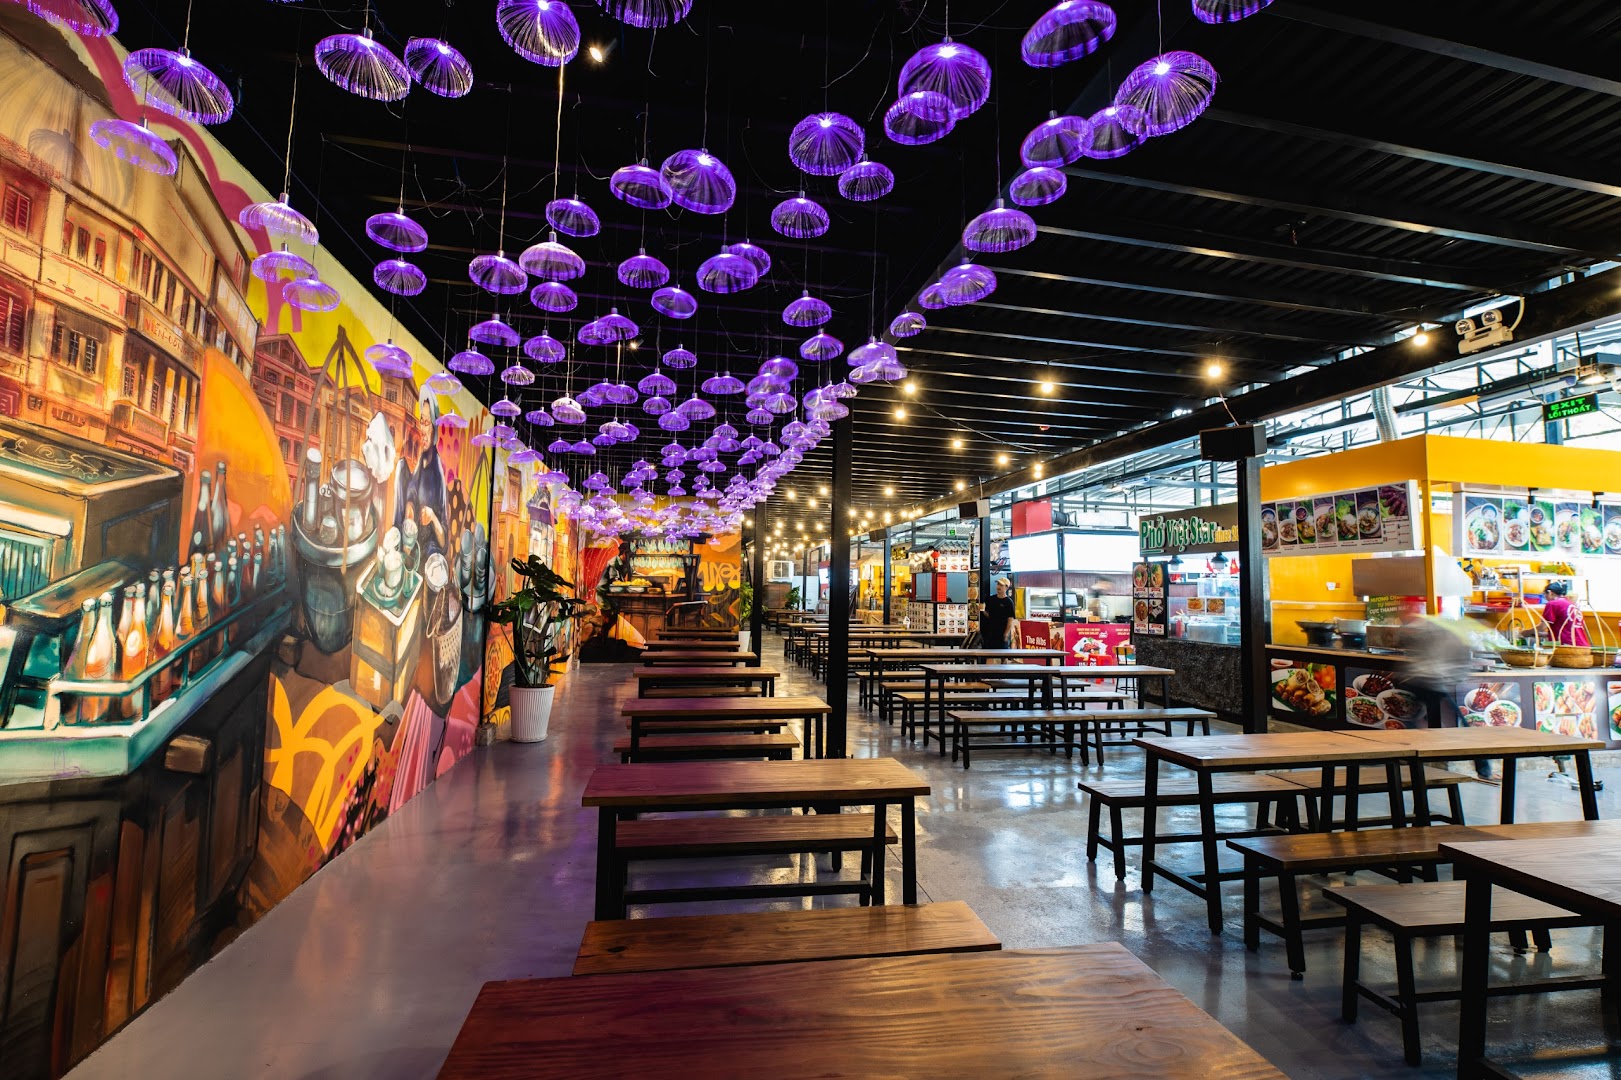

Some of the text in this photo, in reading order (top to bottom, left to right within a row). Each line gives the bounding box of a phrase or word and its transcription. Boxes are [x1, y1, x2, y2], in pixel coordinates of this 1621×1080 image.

[1551, 397, 1586, 410] EXIT
[1141, 515, 1166, 549] Phở
[1166, 517, 1190, 552] Việt
[1190, 515, 1217, 545] Star
[1026, 635, 1047, 646] The Ribs
